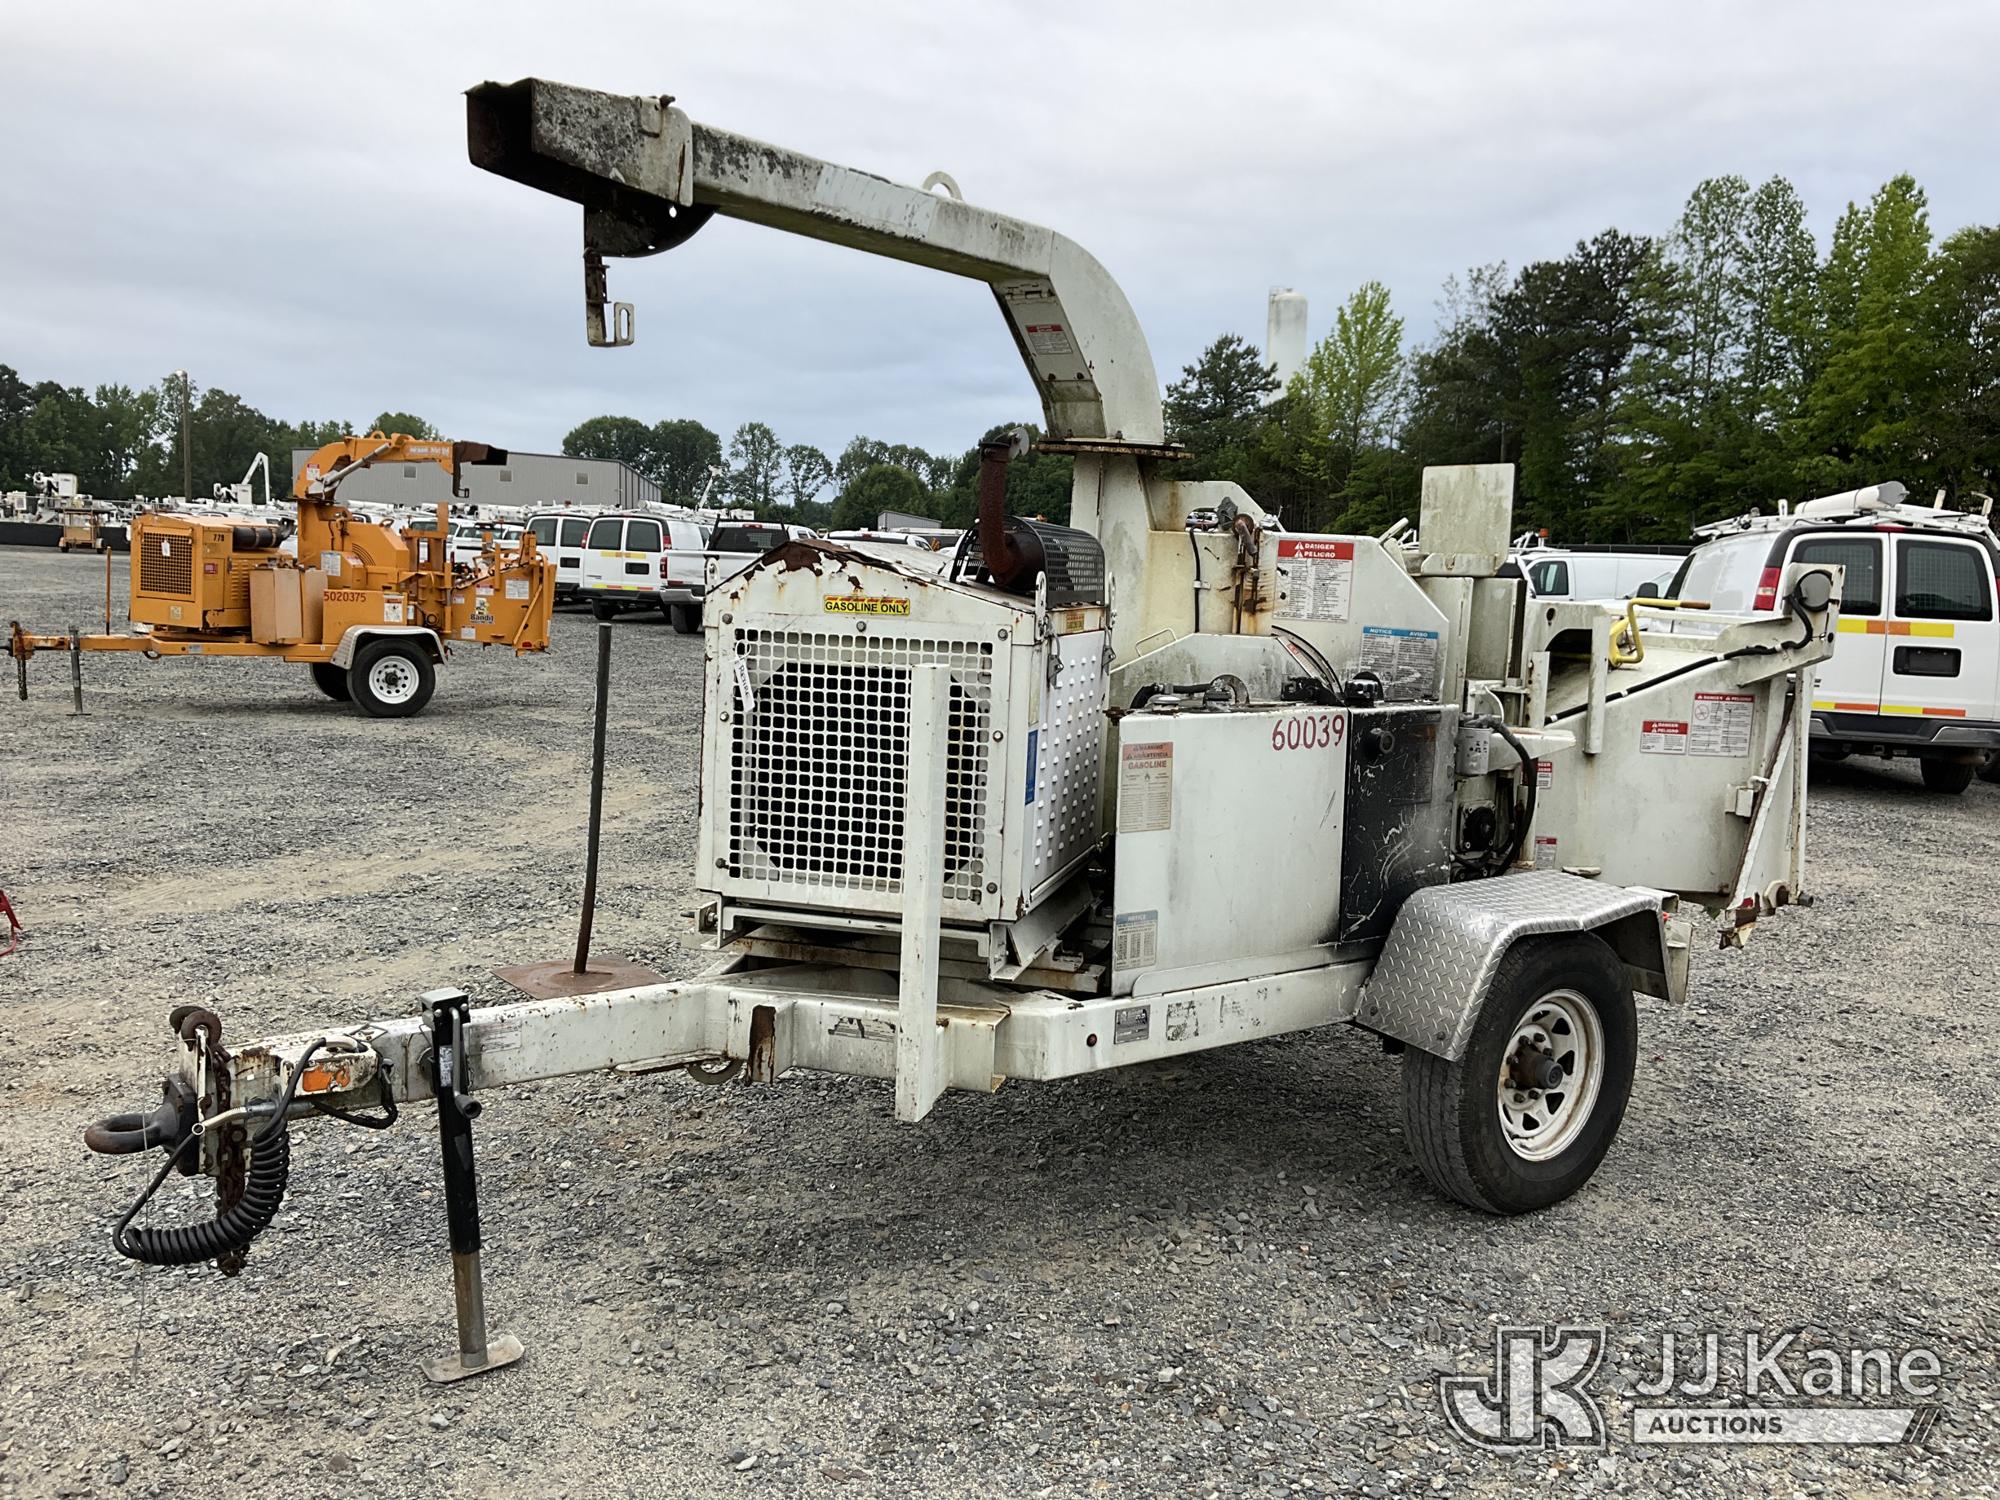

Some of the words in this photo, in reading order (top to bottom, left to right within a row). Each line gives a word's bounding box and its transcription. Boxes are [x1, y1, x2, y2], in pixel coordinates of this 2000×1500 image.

[324, 591, 367, 603] 5020375
[825, 601, 877, 612] GASOLINE
[880, 603, 908, 613] ONLY
[1272, 714, 1345, 751] 60039
[1128, 760, 1167, 769] GASOLINE
